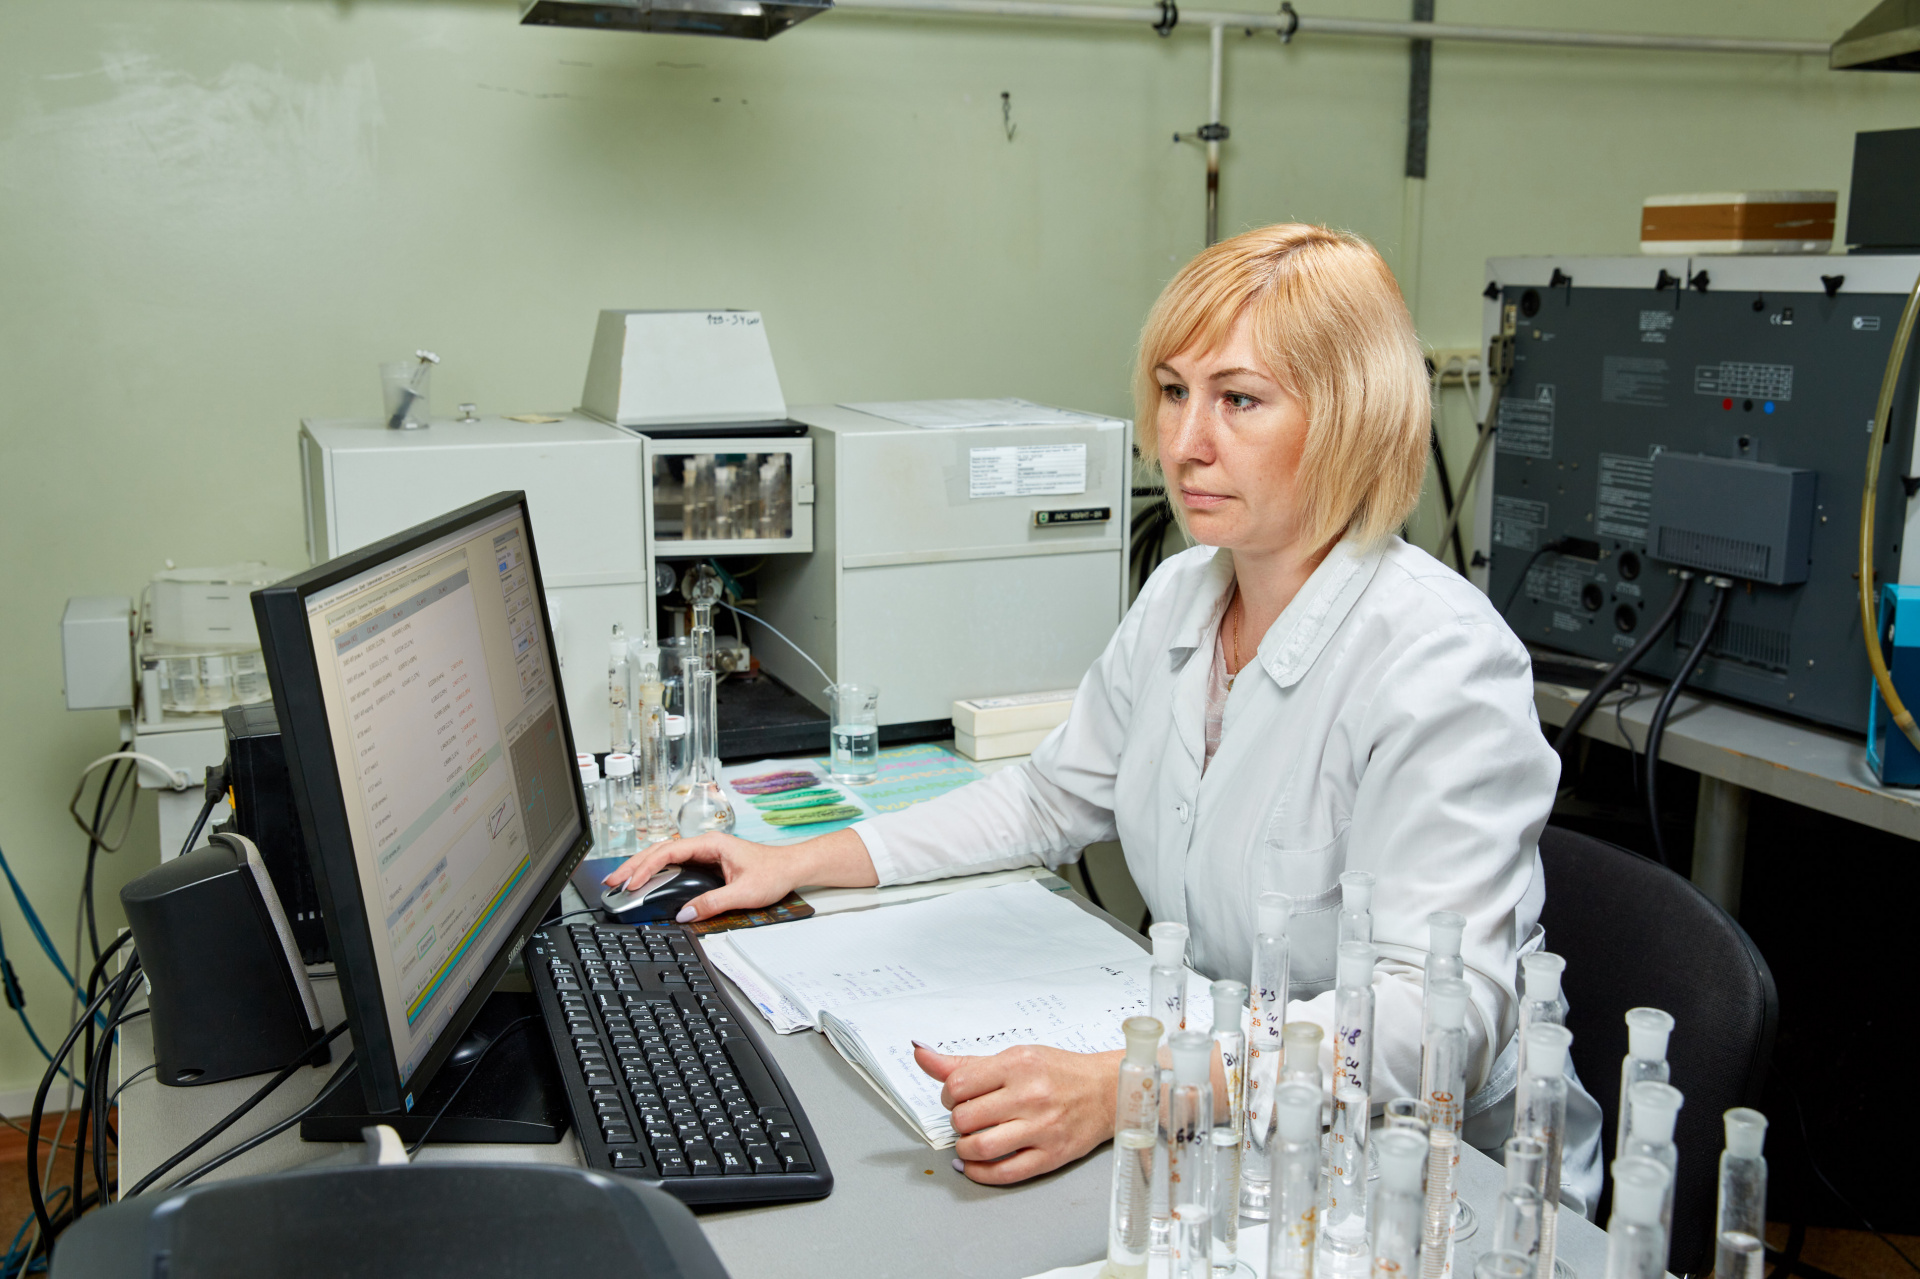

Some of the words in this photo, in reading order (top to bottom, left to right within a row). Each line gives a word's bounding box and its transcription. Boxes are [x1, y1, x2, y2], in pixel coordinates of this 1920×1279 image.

[1252, 1017, 1261, 1027] 25
[1251, 1048, 1260, 1058] 20
[1335, 1066, 1346, 1077] 25
[1250, 1079, 1258, 1090] 15
[1336, 1100, 1346, 1110] 20
[1248, 1110, 1257, 1120] 10
[1334, 1133, 1344, 1143] 15
[1246, 1141, 1251, 1149] 5
[1333, 1165, 1343, 1176] 10
[1332, 1198, 1337, 1207] 5
